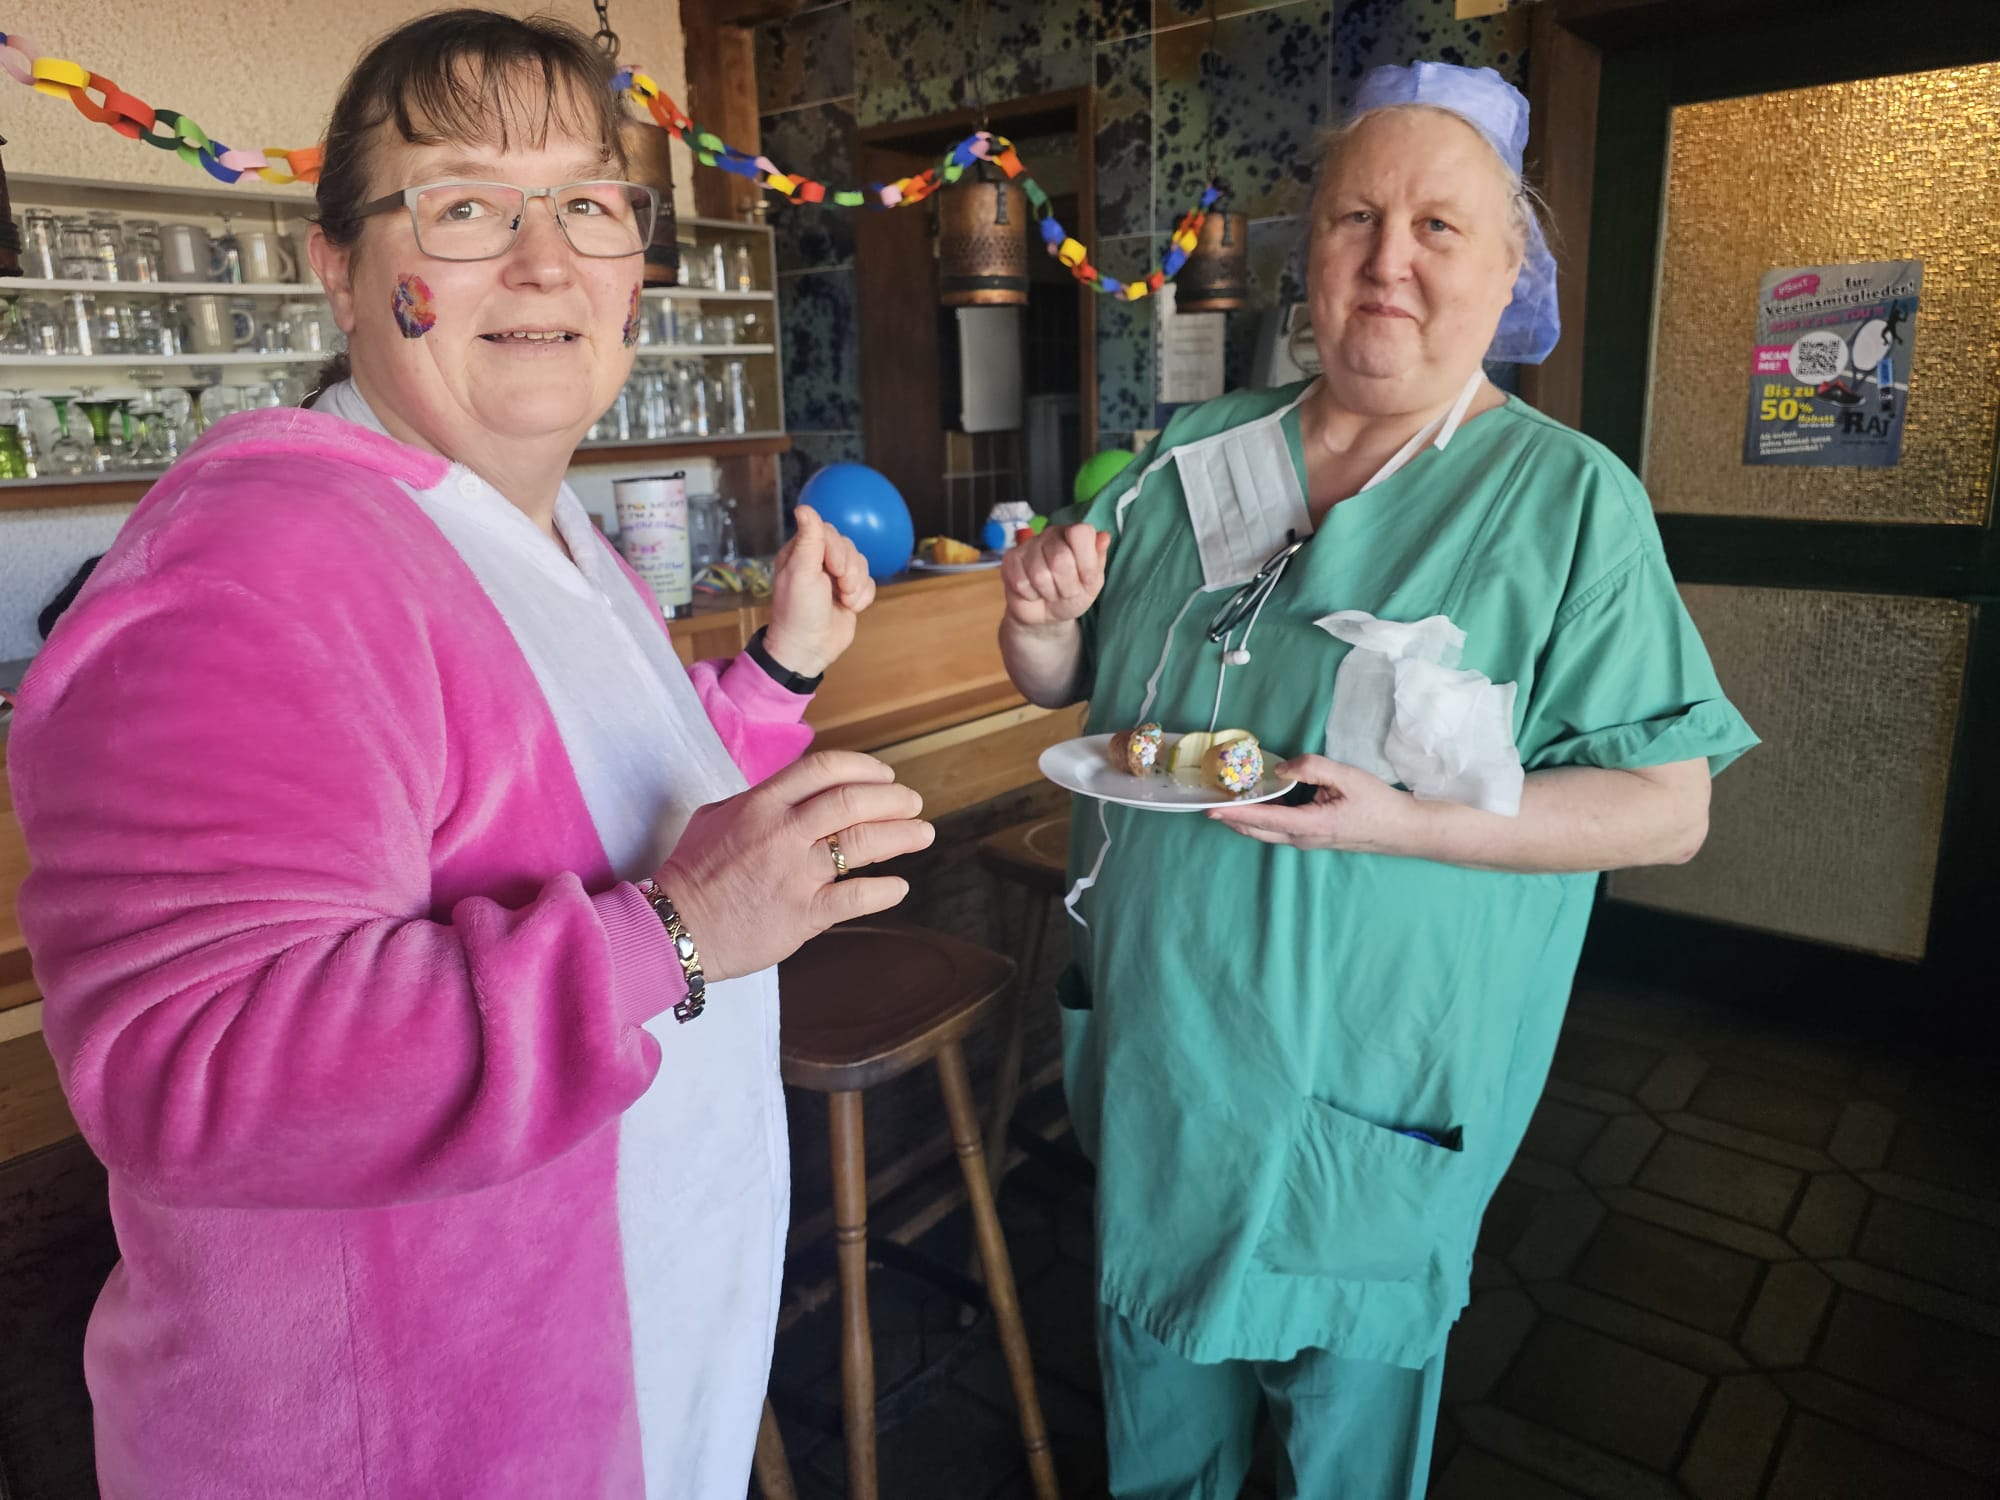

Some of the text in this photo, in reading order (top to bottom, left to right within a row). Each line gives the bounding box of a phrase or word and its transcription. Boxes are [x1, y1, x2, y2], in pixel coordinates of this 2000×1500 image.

[1765, 280, 1914, 316] Vereinsmitglieder!
[1759, 351, 1789, 360] SCAN
[1758, 361, 1781, 371] ME!
[1763, 384, 1816, 398] Bis zu
[1798, 414, 1835, 424] Rabatt
